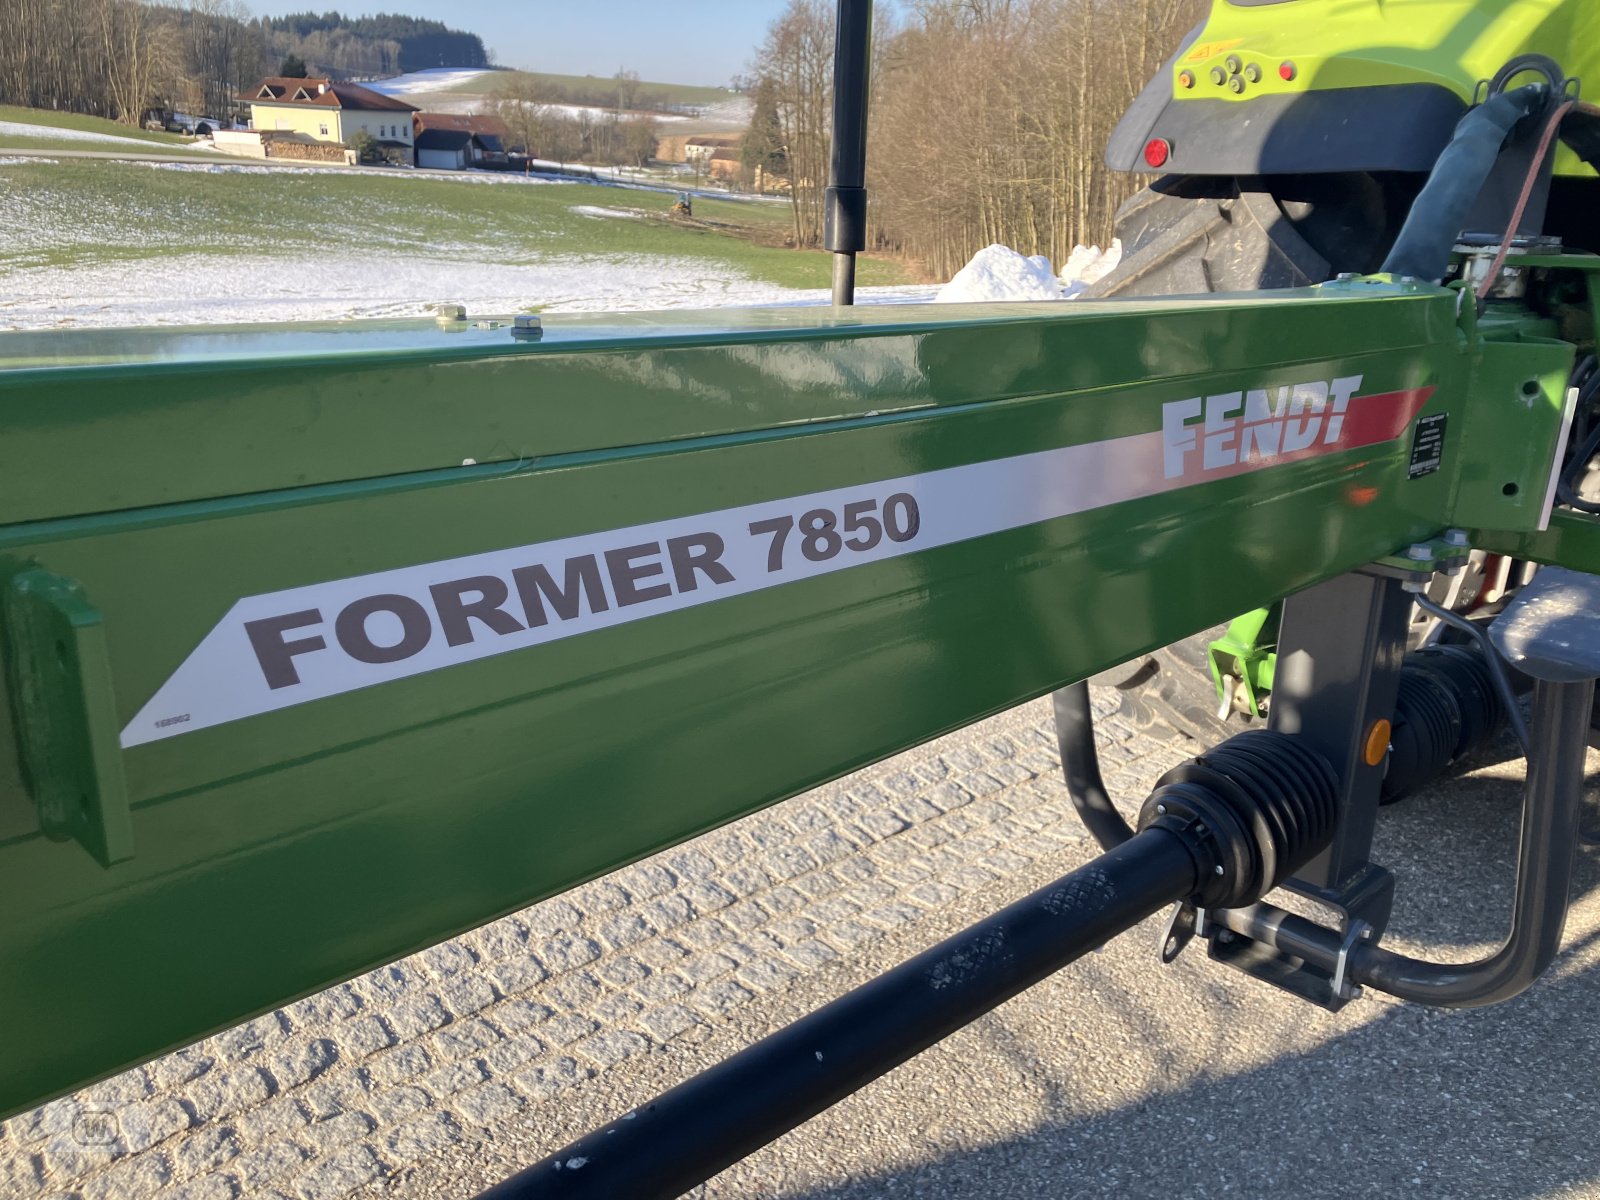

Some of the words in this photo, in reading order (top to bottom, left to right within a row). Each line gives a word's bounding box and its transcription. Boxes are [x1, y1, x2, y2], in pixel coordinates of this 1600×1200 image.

[1162, 375, 1363, 479] FENDT
[244, 532, 736, 690] FORMER
[748, 493, 920, 572] 7850
